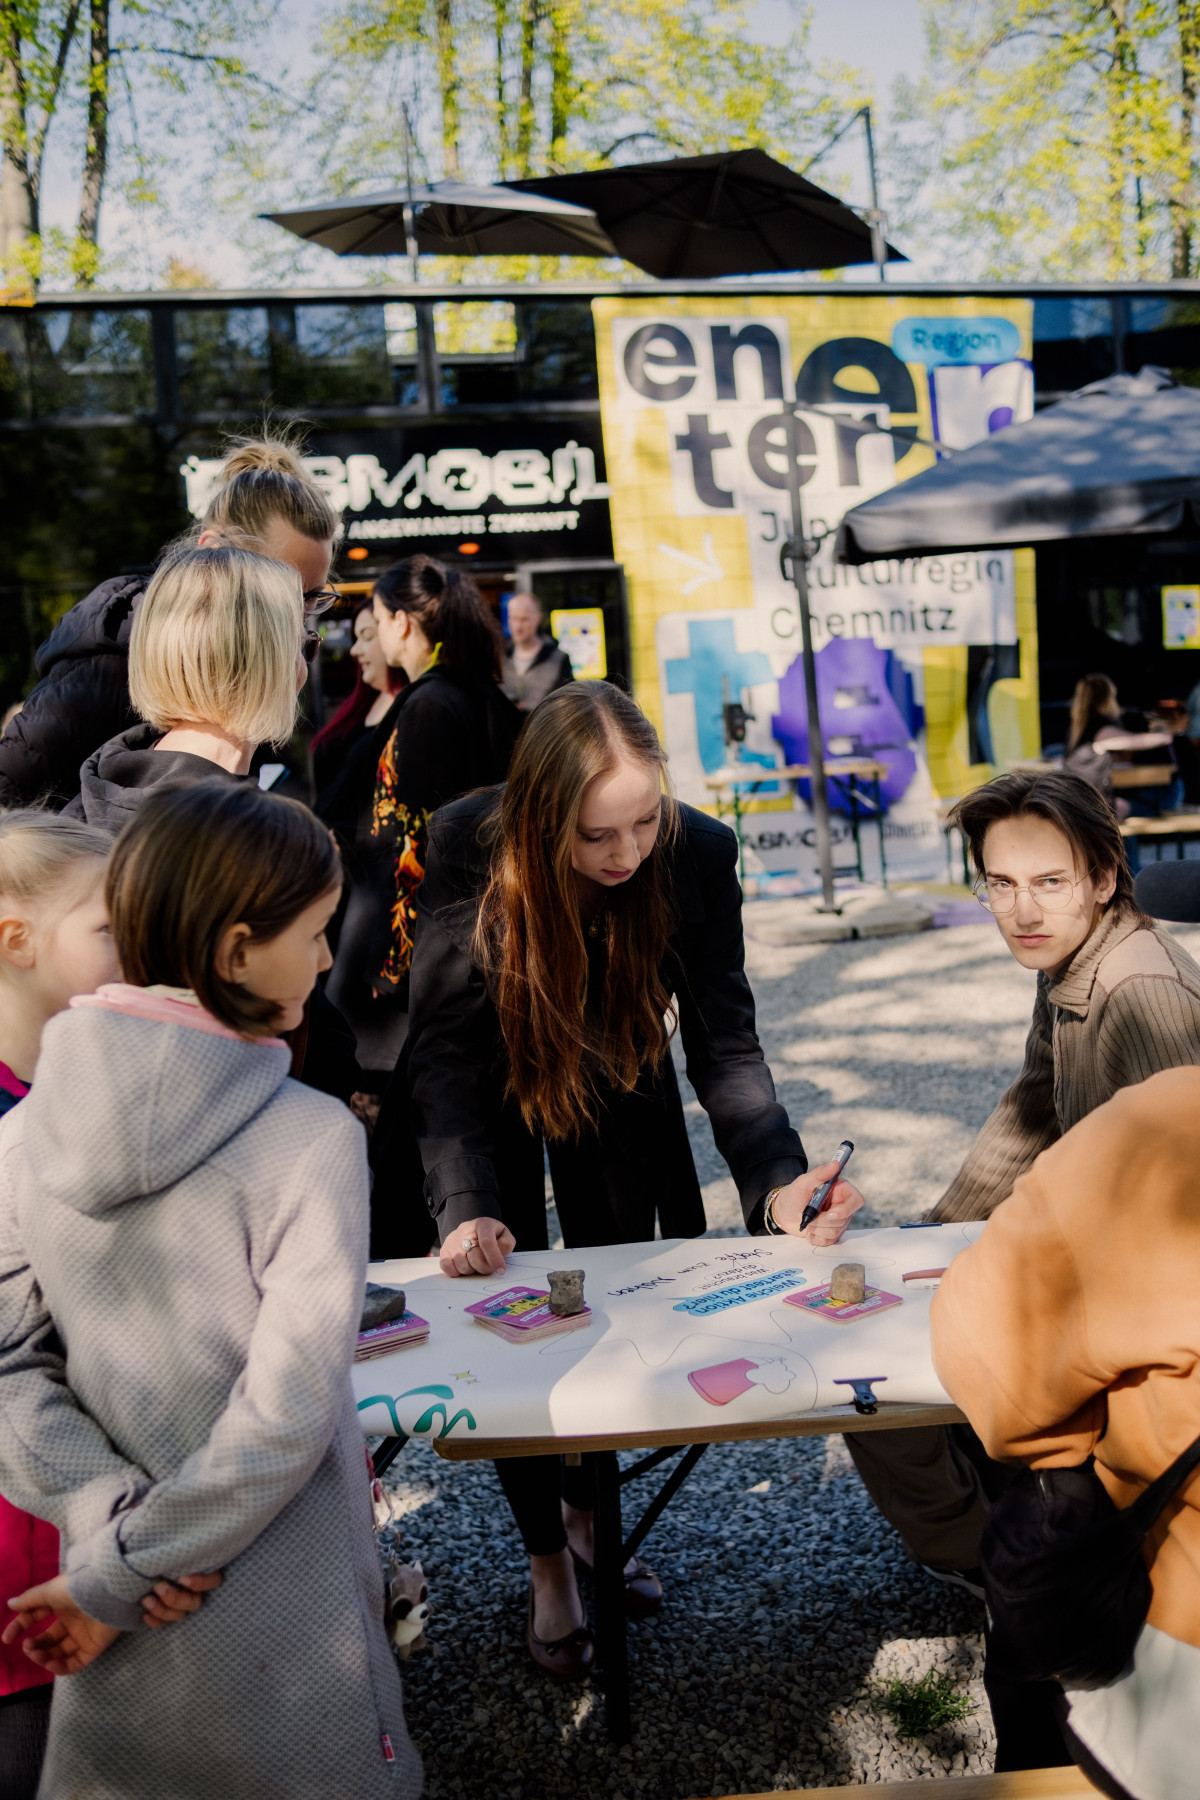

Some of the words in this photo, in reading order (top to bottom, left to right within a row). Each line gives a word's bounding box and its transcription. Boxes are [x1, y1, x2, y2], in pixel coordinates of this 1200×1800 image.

[911, 328, 999, 357] Region
[347, 515, 487, 540] ANGEWANDTE
[488, 510, 580, 534] ZUKUNFT
[738, 1268, 797, 1291] startest
[747, 1267, 771, 1278] Was
[719, 1285, 741, 1297] du
[749, 1278, 801, 1299] Welche
[684, 1291, 720, 1311] hier?
[694, 1294, 748, 1315] Aktion
